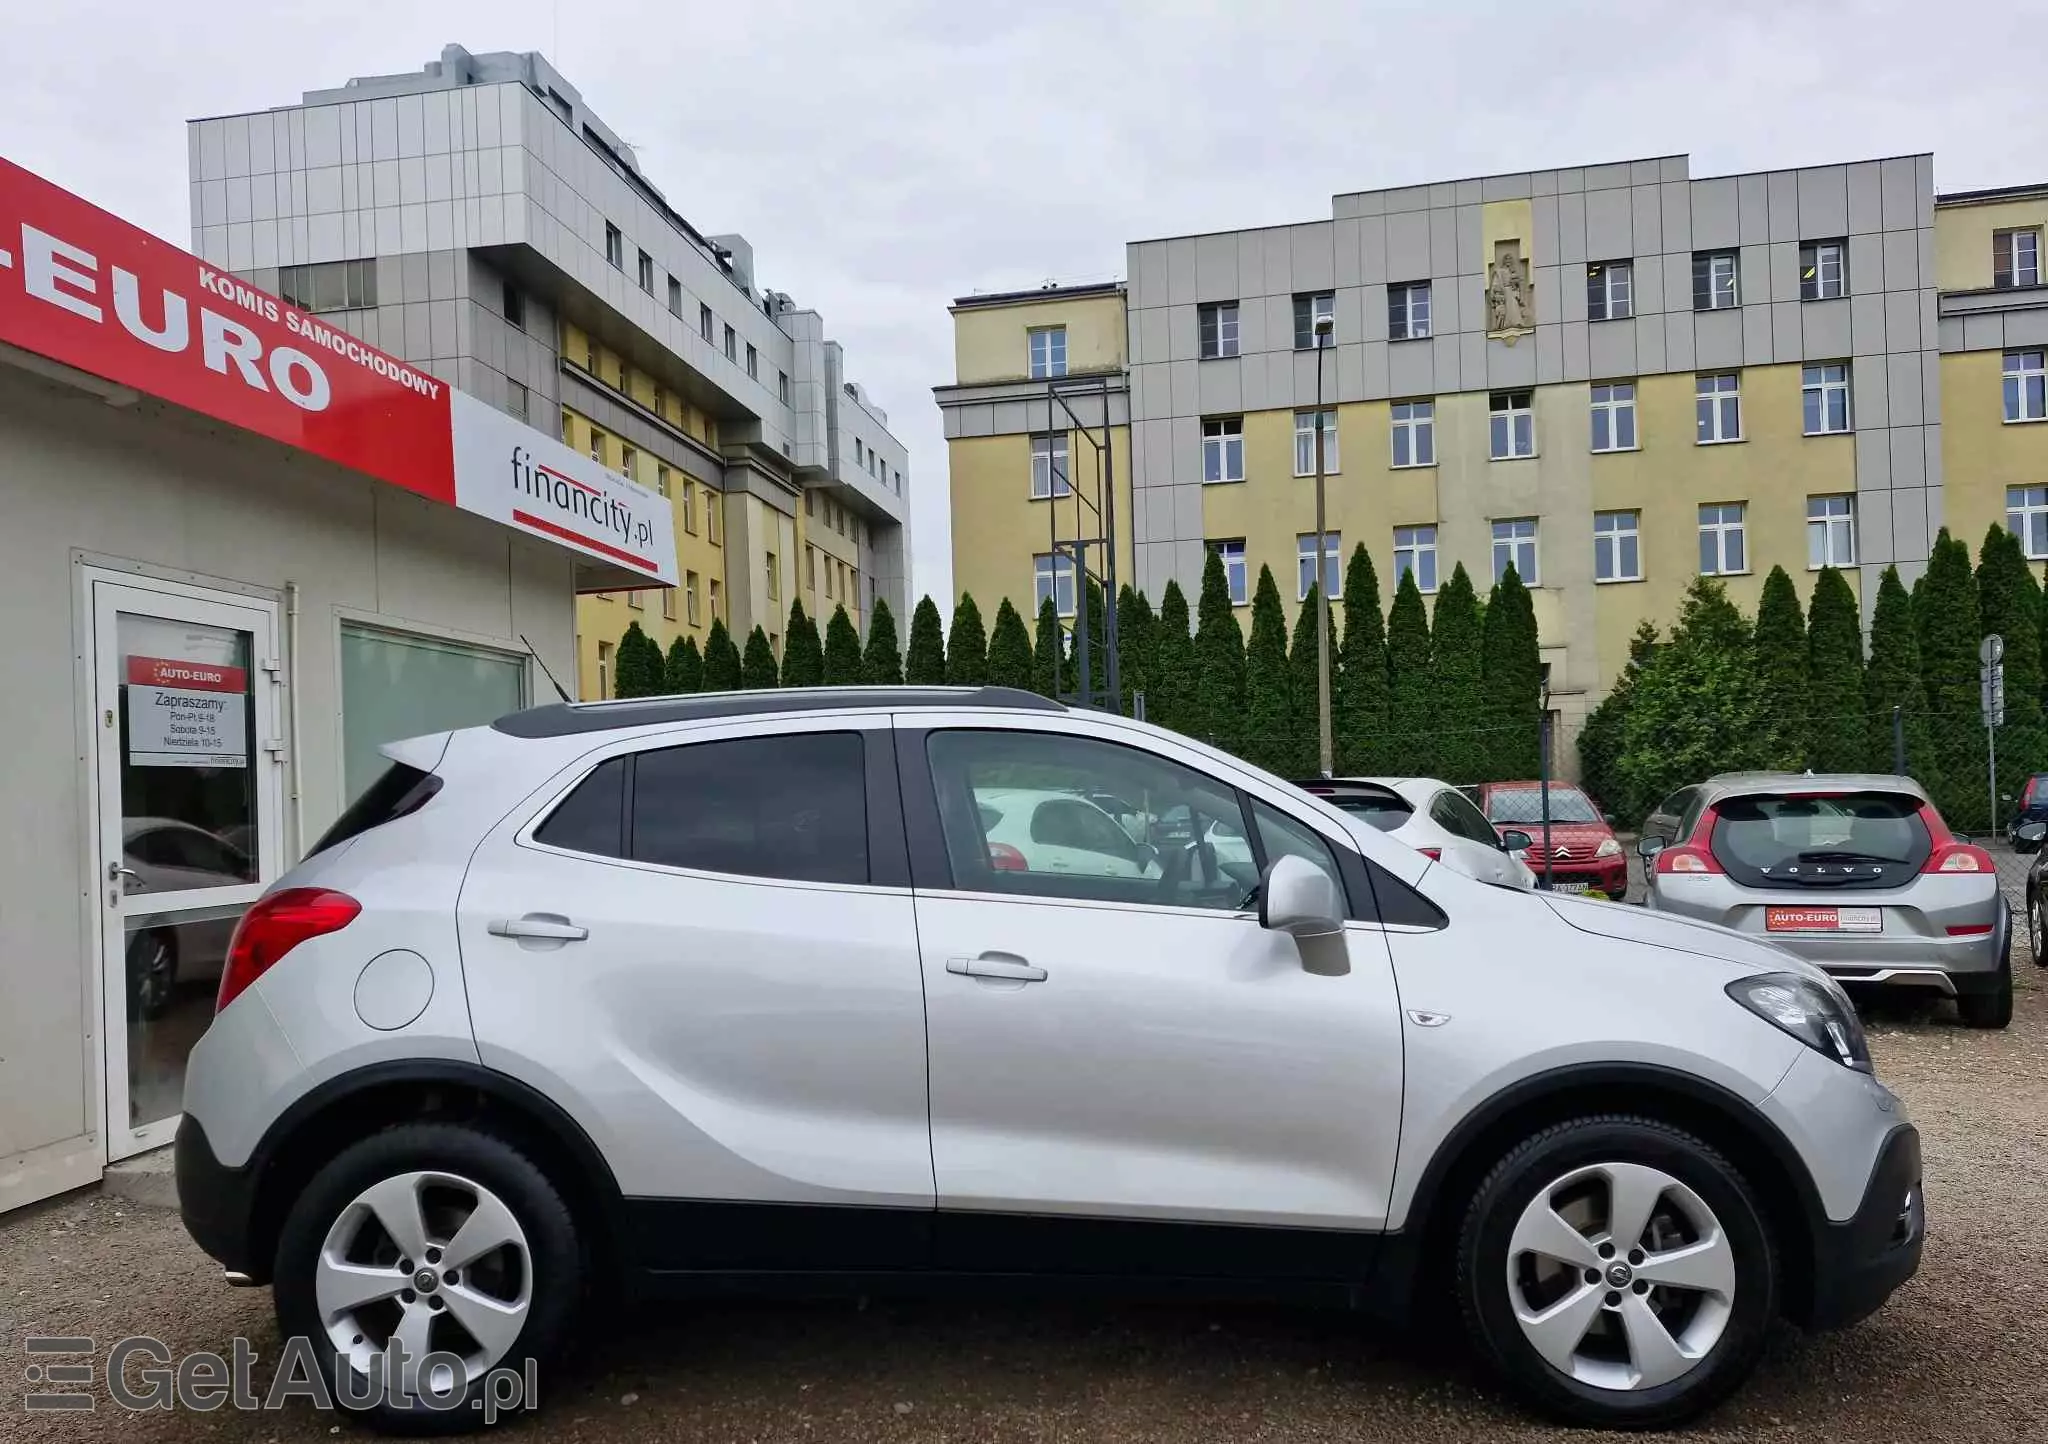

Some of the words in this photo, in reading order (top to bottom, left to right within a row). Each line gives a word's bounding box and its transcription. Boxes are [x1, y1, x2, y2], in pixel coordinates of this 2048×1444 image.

[199, 266, 279, 323] KOMIS
[286, 312, 439, 400] SAMOCHODOWY
[511, 446, 653, 548] financity.pl
[160, 667, 222, 682] AUTO-EURO
[1774, 913, 1837, 922] AUTO-EURO
